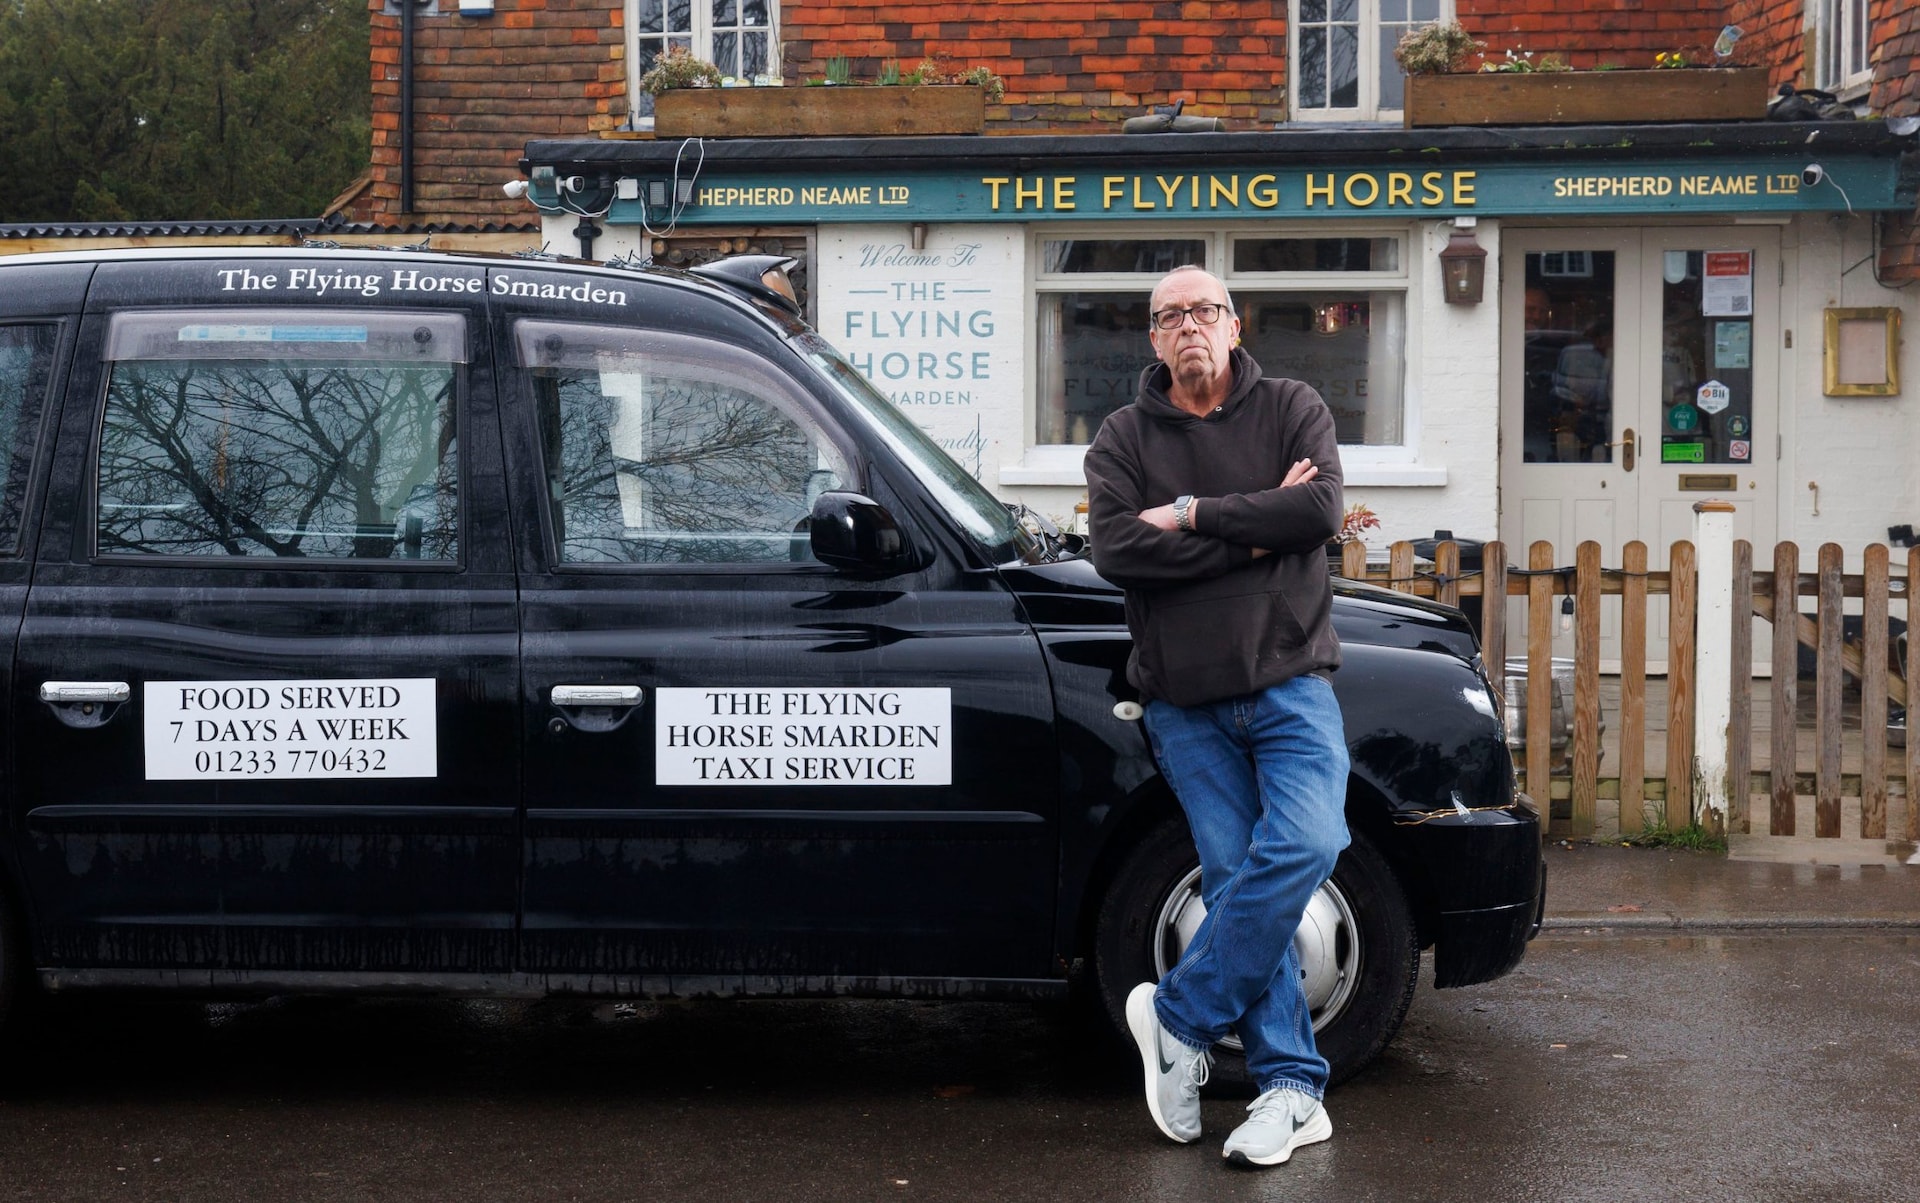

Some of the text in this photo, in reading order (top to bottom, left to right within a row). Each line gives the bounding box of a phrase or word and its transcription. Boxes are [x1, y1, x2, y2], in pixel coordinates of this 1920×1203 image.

[700, 187, 794, 206] HEPHERD
[801, 187, 871, 204] NEAME
[982, 171, 1477, 210] THE FLYING HORSE
[1554, 177, 1673, 197] SHEPHERD
[1680, 175, 1758, 195] NEAME
[859, 243, 983, 268] Welcome To
[217, 268, 627, 306] The Flying Horse Smarden
[891, 282, 946, 301] THE
[846, 310, 994, 338] FLYING
[850, 352, 990, 379] HORSE
[883, 391, 971, 405] MARDEN
[179, 686, 401, 710] FOOD SERVED
[705, 692, 902, 716] THE FLYING
[170, 718, 410, 743] 7 DAYS A WEEK
[667, 724, 941, 748] HORSE SMARDEN
[195, 747, 387, 774] 01233 770432
[693, 757, 916, 780] TAXI SERVICE
